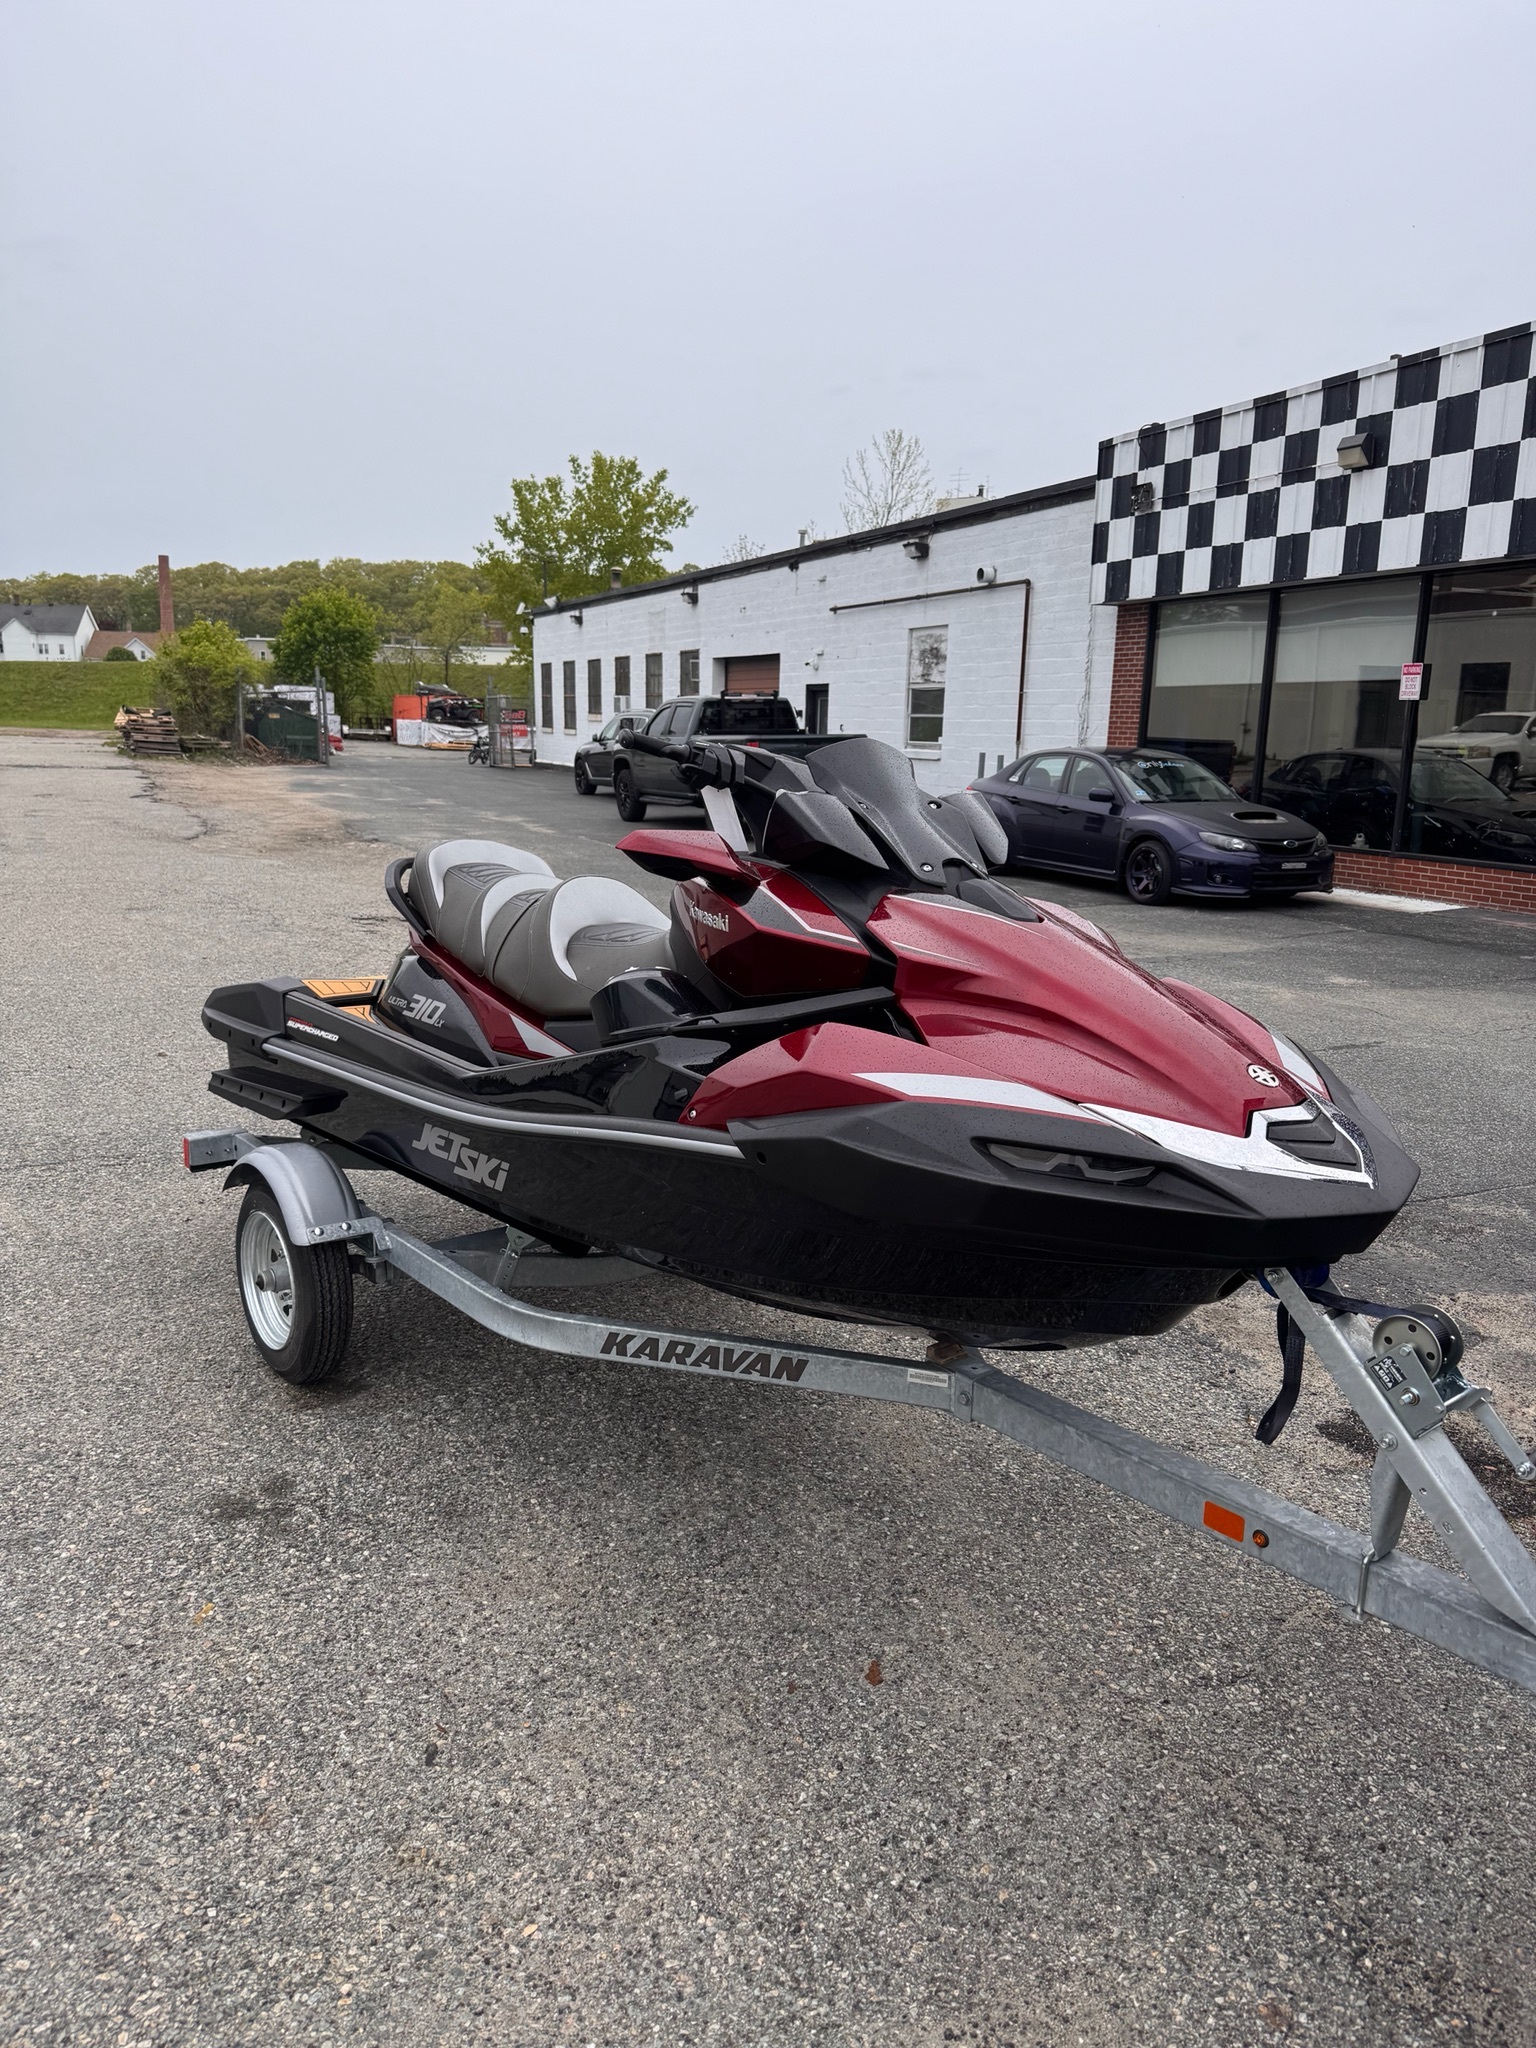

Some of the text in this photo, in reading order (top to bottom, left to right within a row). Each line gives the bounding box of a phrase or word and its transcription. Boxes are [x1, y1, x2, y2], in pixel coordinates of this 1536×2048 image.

[387, 995, 408, 1009] ULTRA
[402, 993, 447, 1025] 310
[286, 1020, 339, 1041] SUPERCHARGED
[411, 1122, 471, 1164] JET
[600, 1331, 810, 1383] KARAVAN
